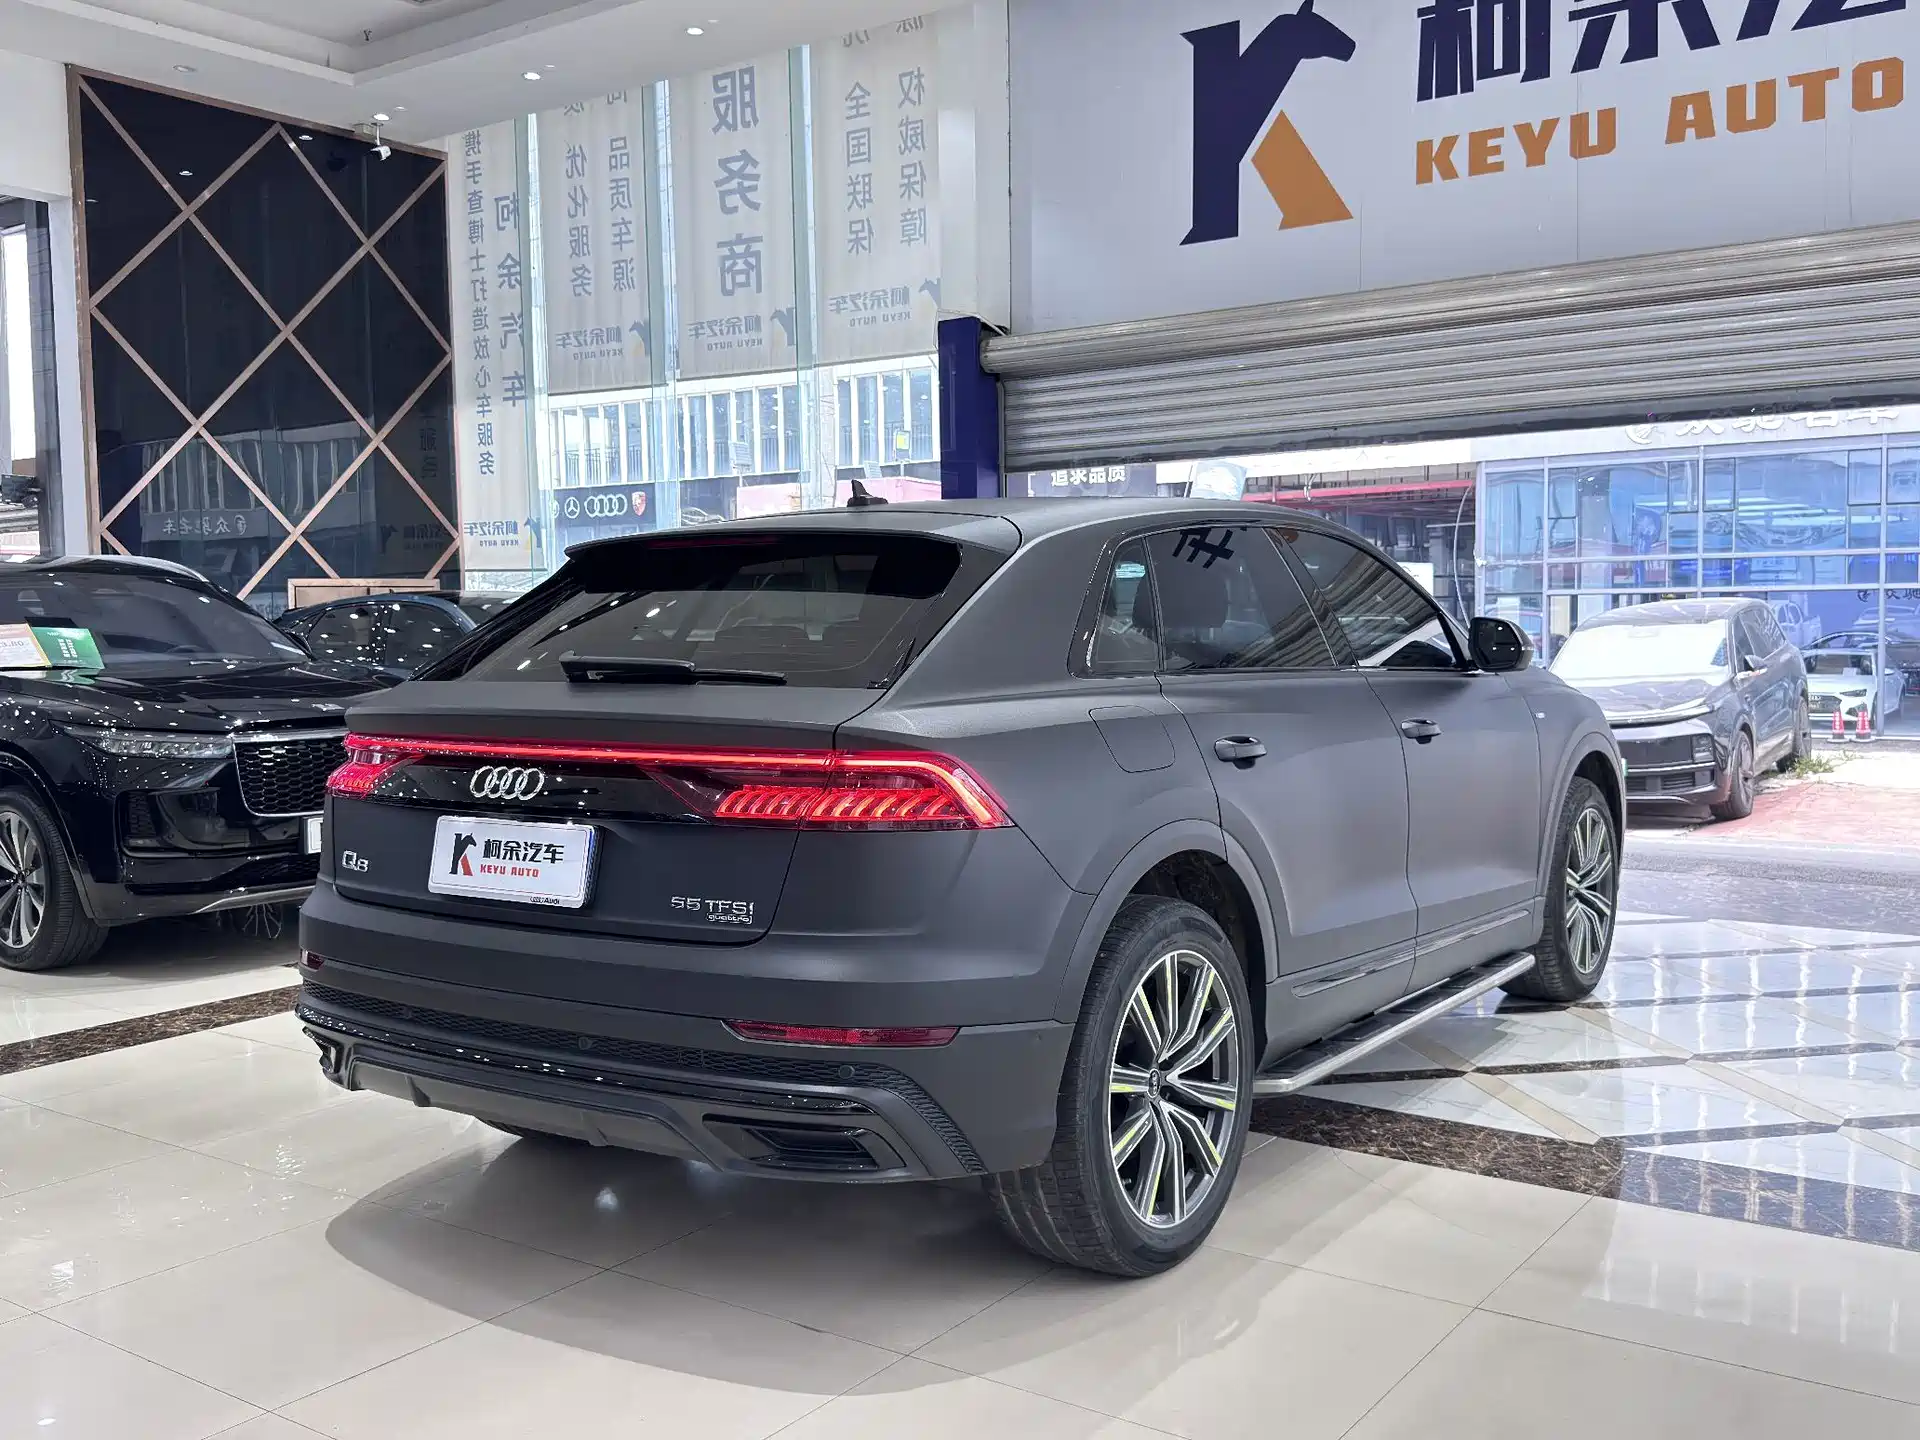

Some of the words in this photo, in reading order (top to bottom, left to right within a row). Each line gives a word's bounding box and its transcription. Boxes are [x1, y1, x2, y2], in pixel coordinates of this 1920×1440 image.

[1416, 107, 1617, 185] KEYU
[1665, 57, 1904, 144] AUTO
[342, 850, 369, 872] Q8
[483, 838, 565, 864] 柯余汽车
[480, 864, 506, 875] KEYU
[511, 867, 539, 877] AUTO
[671, 896, 701, 911] 55
[705, 900, 755, 915] TFSI
[707, 914, 750, 922] quattro
